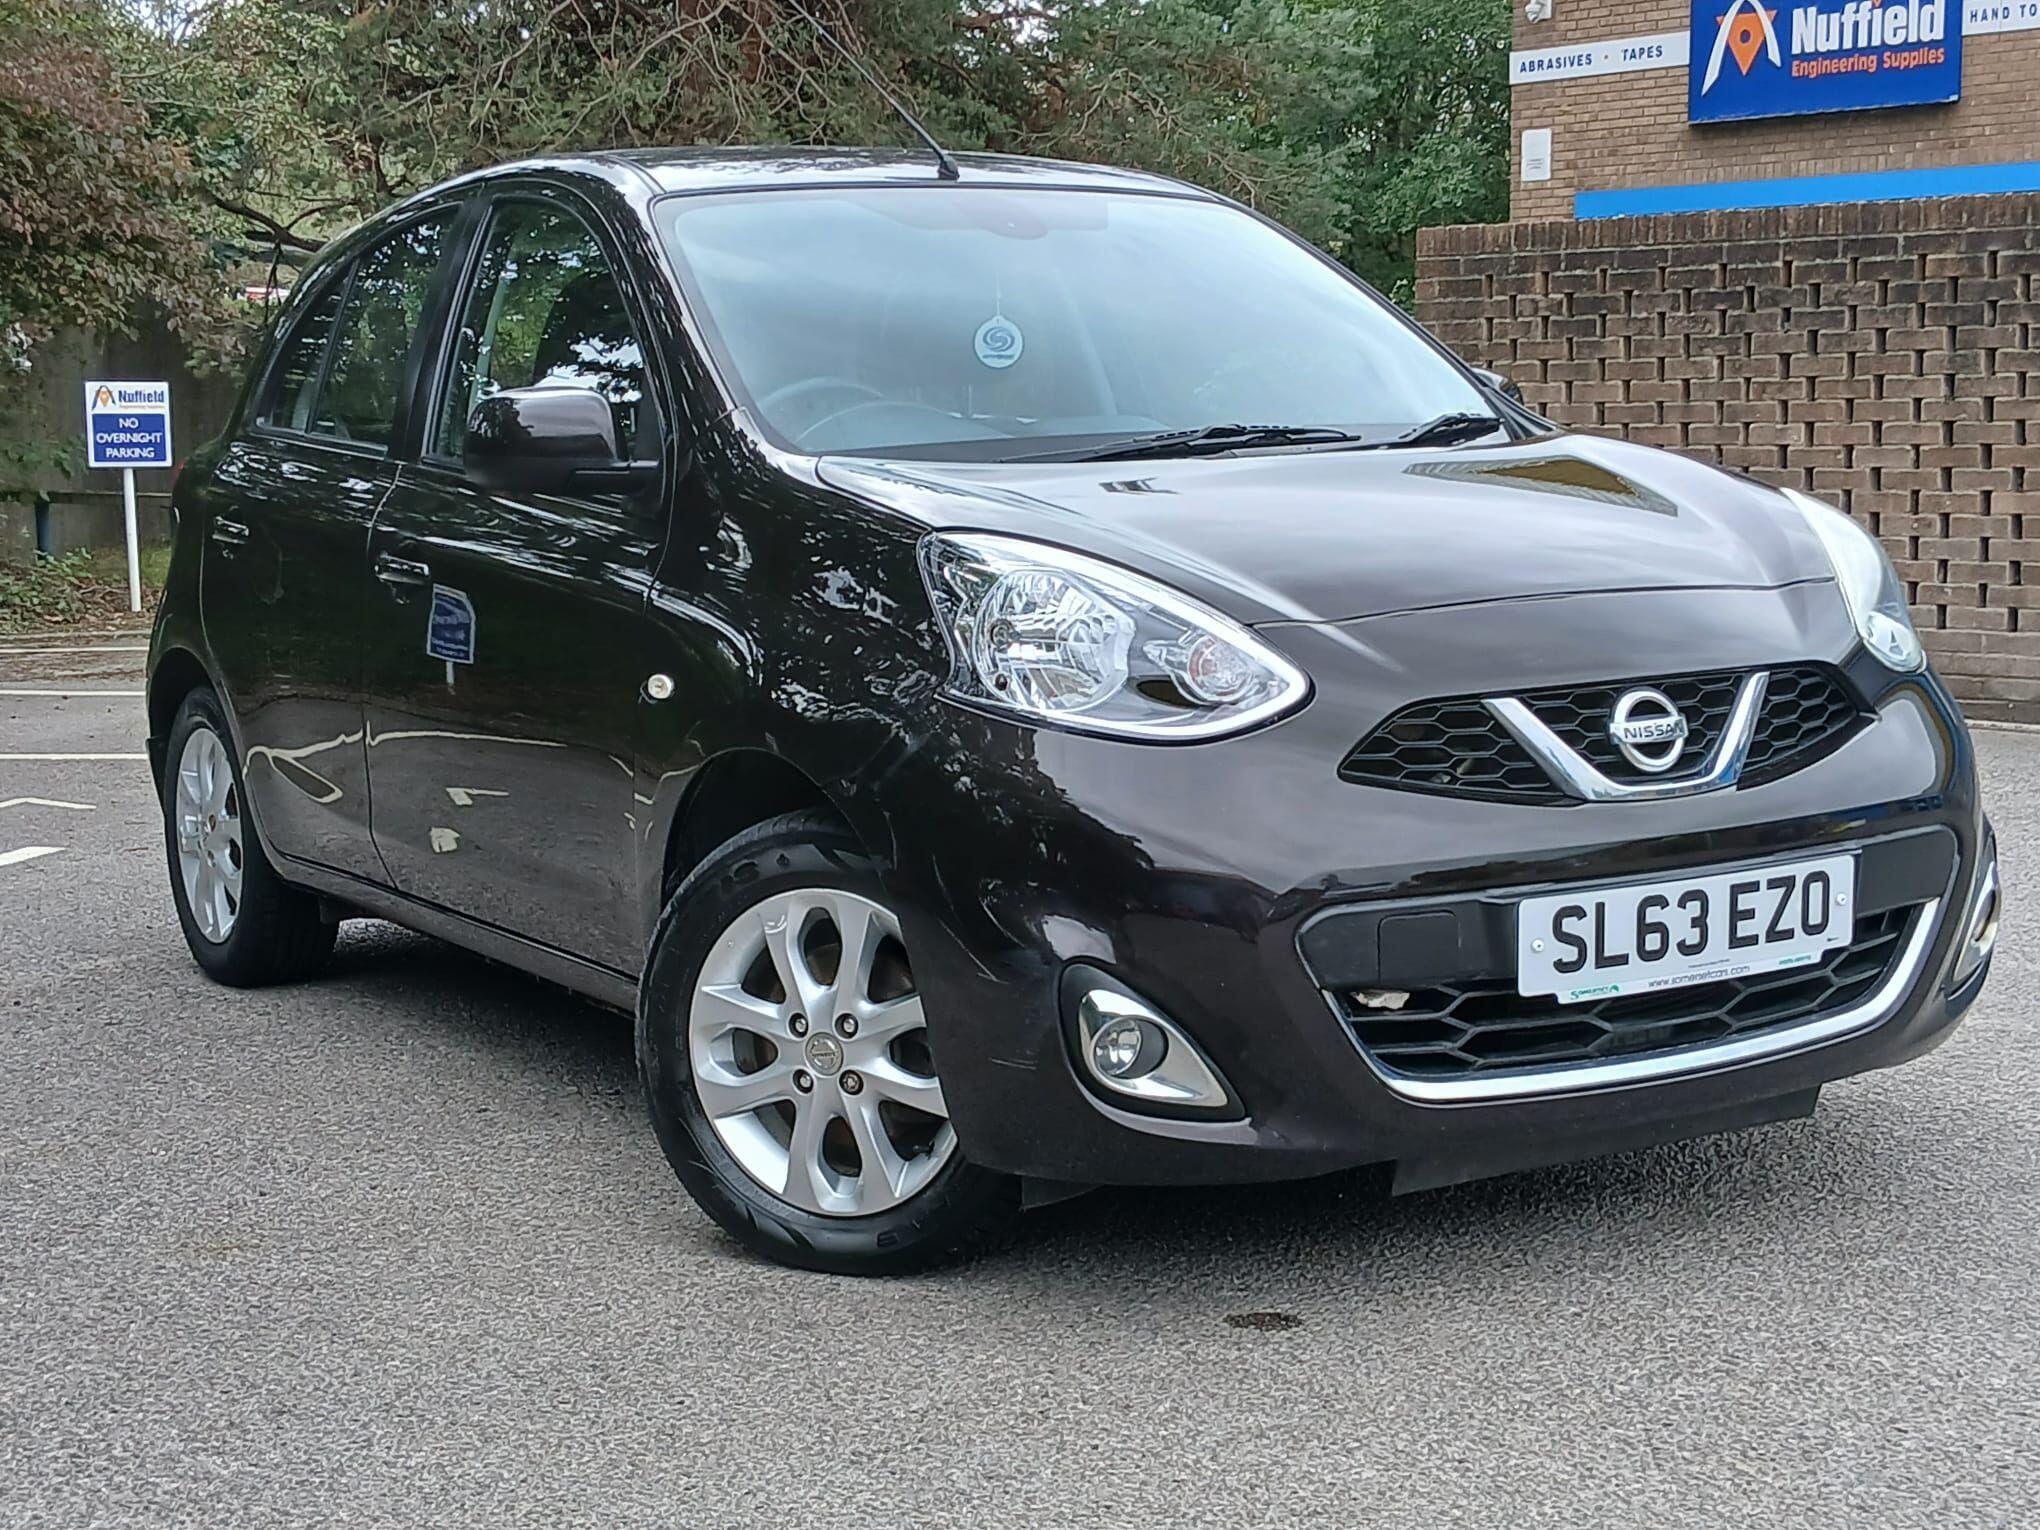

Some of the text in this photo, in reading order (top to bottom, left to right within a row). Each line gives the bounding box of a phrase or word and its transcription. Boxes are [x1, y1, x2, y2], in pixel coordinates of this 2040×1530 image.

[1970, 7, 2010, 25] HAND
[1792, 0, 1946, 54] Nuffield
[1519, 45, 1663, 73] ABRASIVES TAPES
[1791, 47, 1945, 79] Engineering Supplies
[118, 390, 165, 403] Nuffield
[118, 417, 139, 429] NO
[96, 432, 163, 444] OVERNIGHT
[105, 447, 155, 458] PARKING
[1623, 721, 1684, 739] NISSAN
[1551, 870, 1831, 974] SL63 EZO
